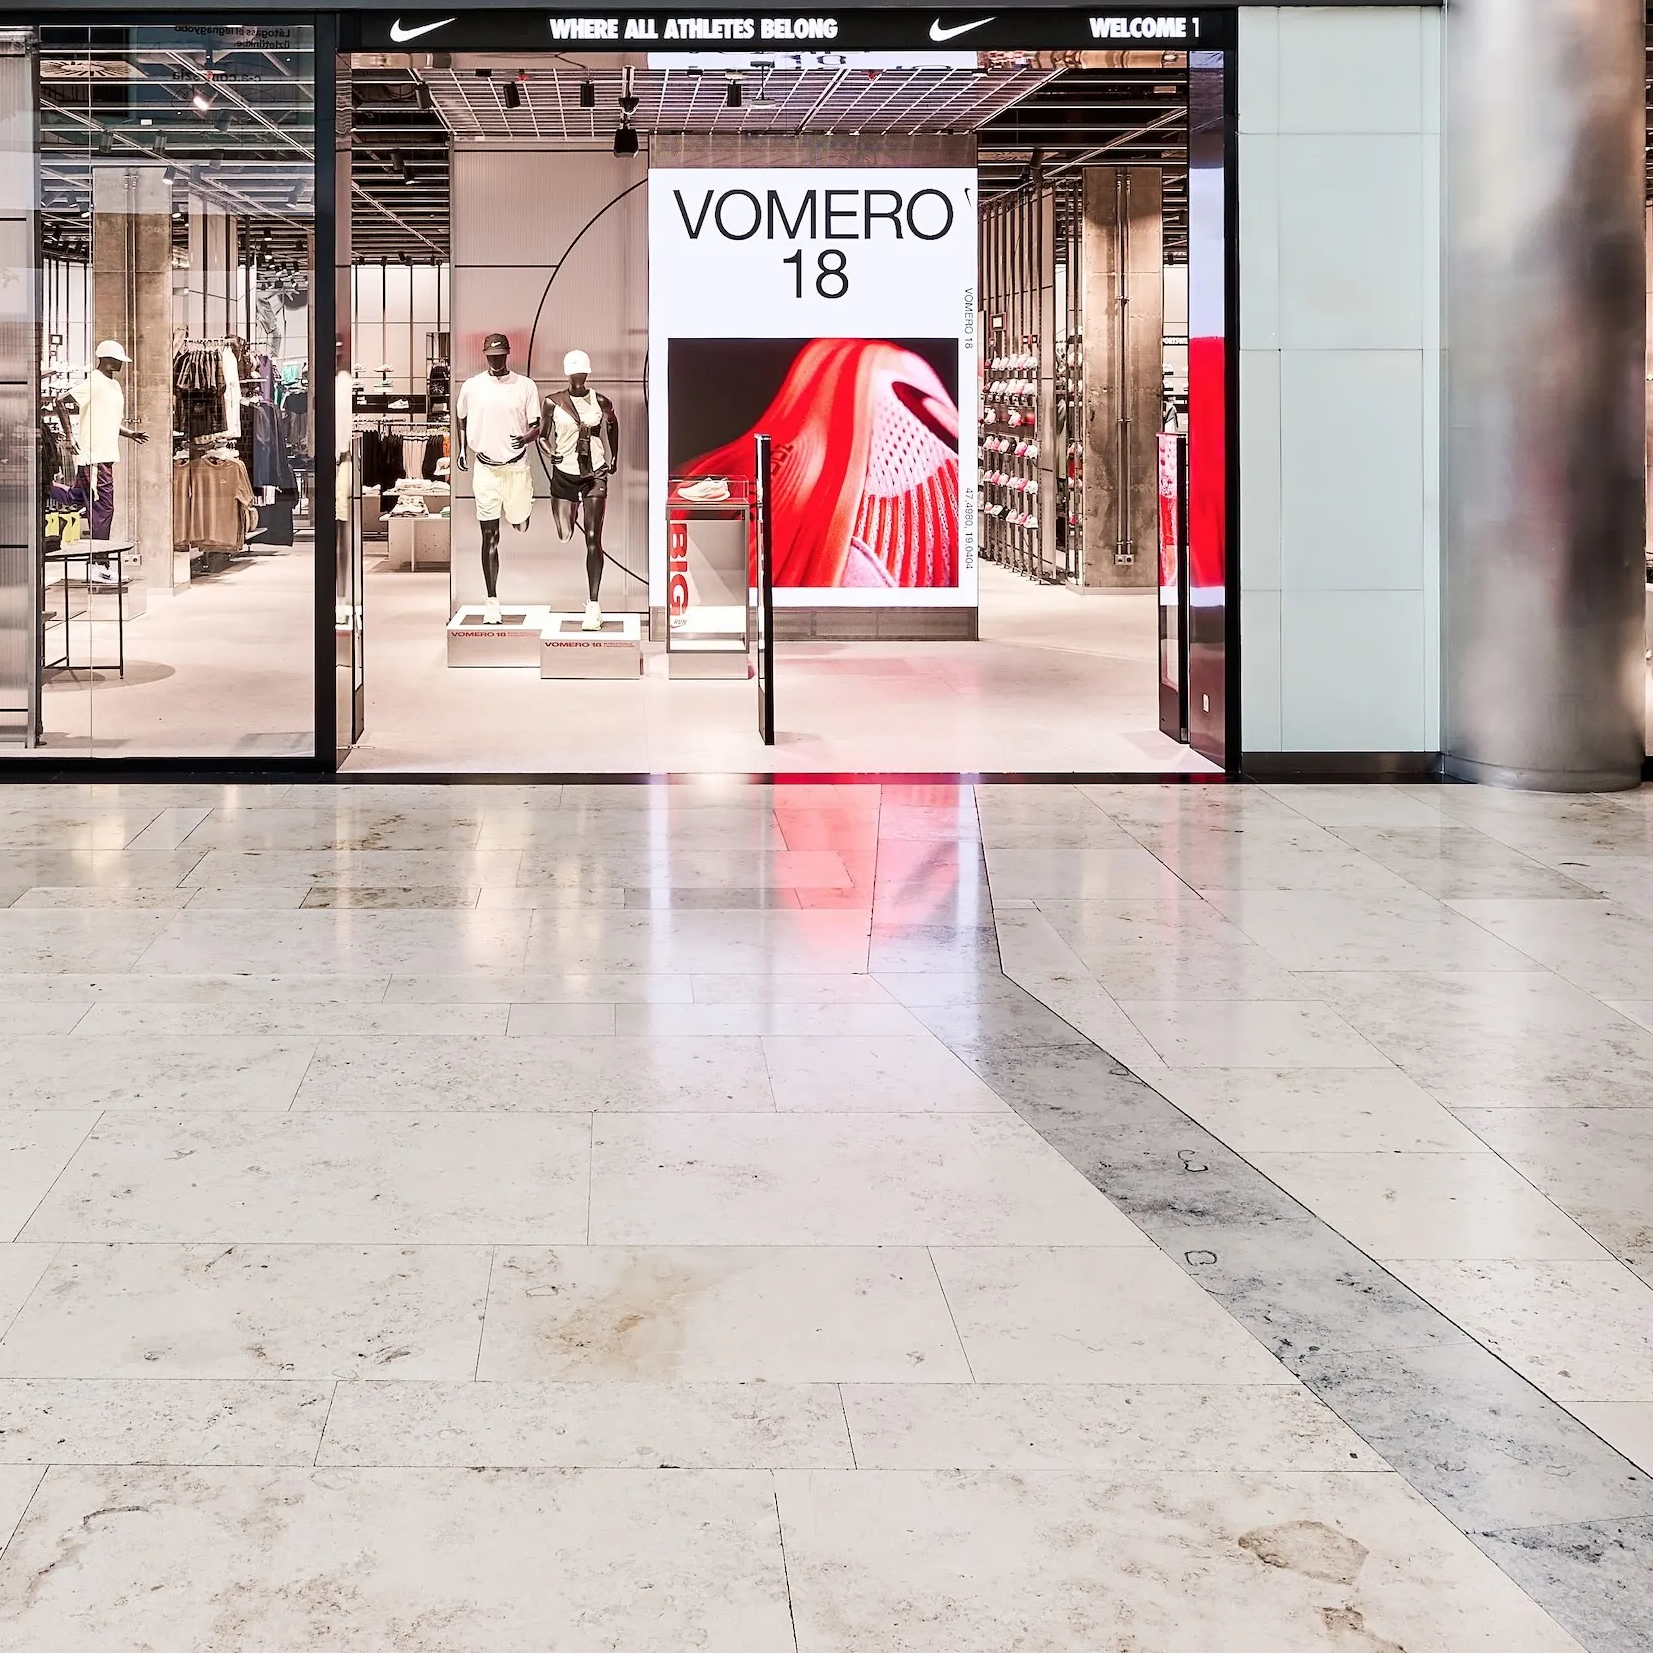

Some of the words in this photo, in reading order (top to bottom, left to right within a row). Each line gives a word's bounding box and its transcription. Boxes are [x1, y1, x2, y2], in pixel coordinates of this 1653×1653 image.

[549, 17, 619, 40] WHERE
[624, 18, 659, 40] ALL
[664, 17, 755, 40] ATHLETES
[761, 17, 839, 40] BELONG
[1089, 17, 1187, 39] WELCOME
[673, 188, 954, 241] VOMERO
[783, 248, 849, 299] 18
[964, 287, 974, 335] VOMERO
[964, 337, 974, 349] 18
[963, 488, 974, 529] 47.4980,
[669, 523, 689, 616] BIG
[964, 532, 974, 570] 19.0404
